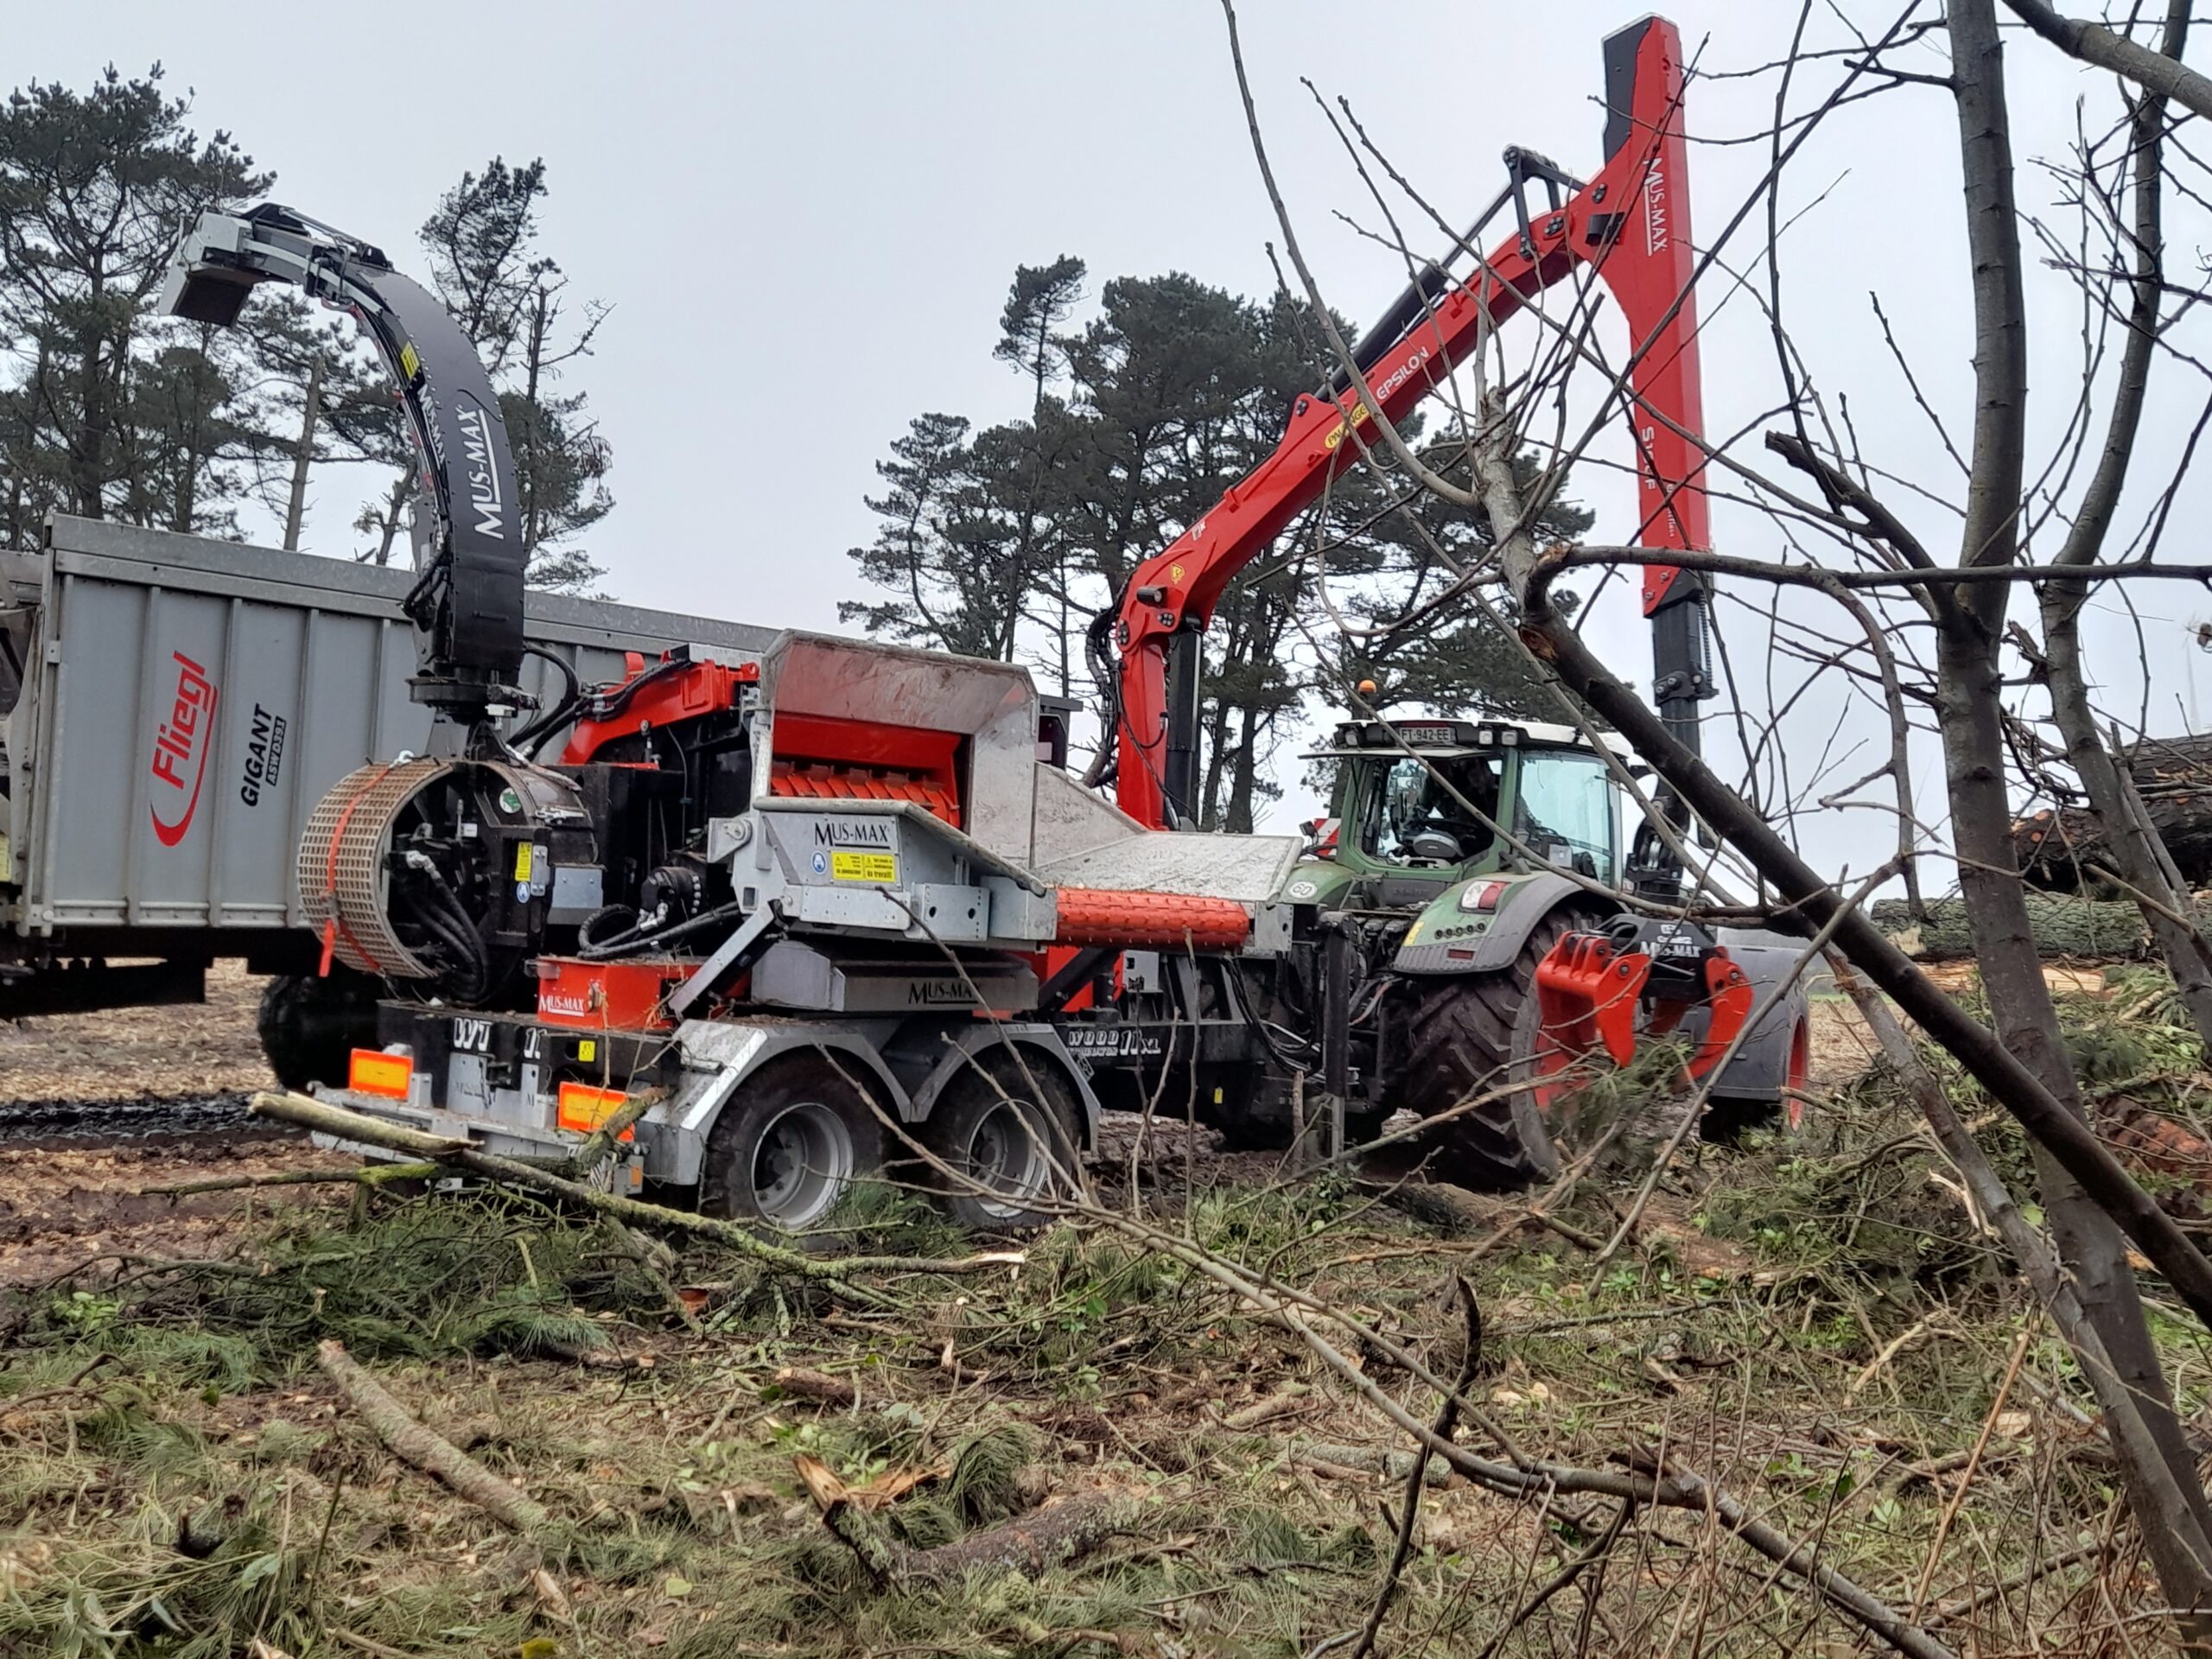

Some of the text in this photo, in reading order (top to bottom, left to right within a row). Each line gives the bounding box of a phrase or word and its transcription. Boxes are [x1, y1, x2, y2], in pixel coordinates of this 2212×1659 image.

[1643, 157, 1669, 254] MUS-MAX
[1376, 346, 1430, 401] EPSILON
[455, 404, 505, 540] MUS-MAX
[152, 650, 211, 790] Fliegl
[1401, 728, 1450, 741] FT-942-EE
[240, 702, 272, 807] GIGANT
[815, 823, 888, 847] MUS-MAX
[538, 994, 585, 1014] MUS-MAX
[454, 1017, 493, 1052] WT
[1069, 1030, 1119, 1046] WOOD
